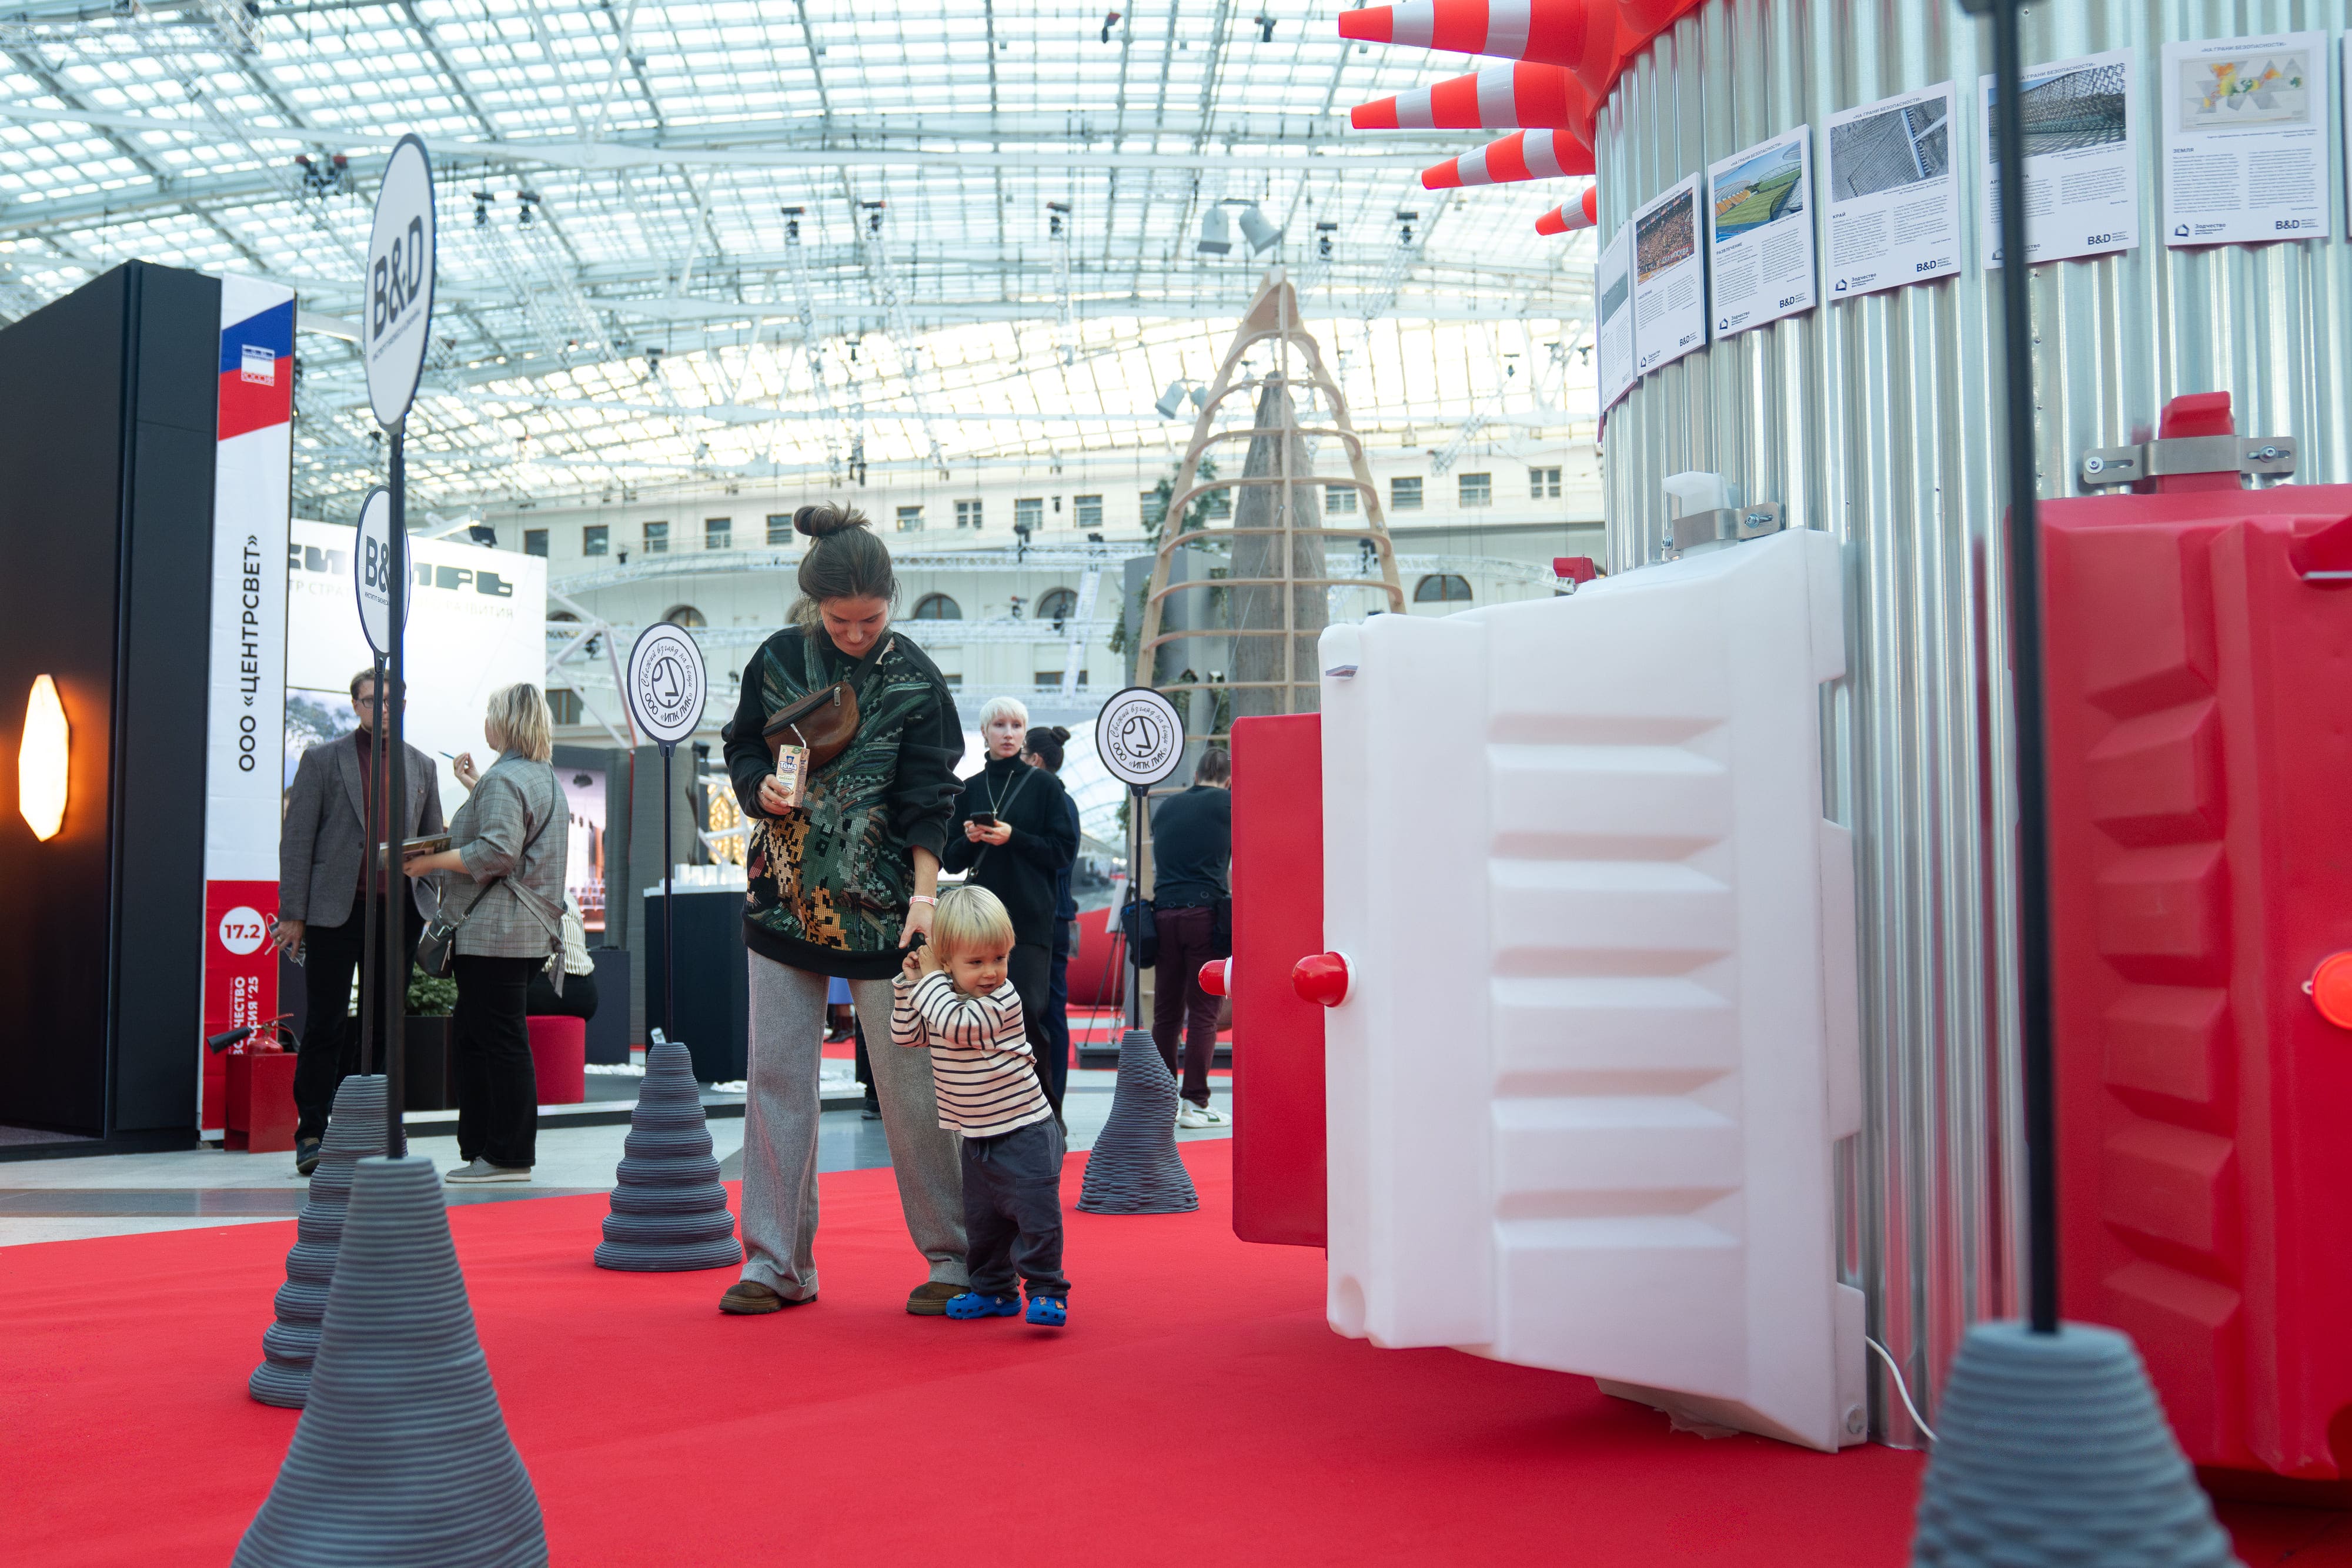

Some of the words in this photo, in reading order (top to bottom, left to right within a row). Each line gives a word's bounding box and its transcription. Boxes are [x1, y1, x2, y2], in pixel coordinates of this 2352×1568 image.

[1863, 109, 1879, 117] ГРАНИ
[2276, 220, 2300, 229] B&D
[2088, 234, 2110, 245] B&D
[373, 215, 423, 342] B&D
[1852, 273, 1876, 282] Зодчество
[1916, 260, 1936, 272] B&D
[1779, 296, 1795, 308] B&D
[1679, 335, 1690, 346] B&D
[365, 535, 390, 593] B&
[240, 534, 261, 707] «ЦЕНТРСВЕТ»
[640, 649, 657, 687] Свежий
[657, 643, 679, 657] взгляд
[679, 653, 687, 663] на
[644, 693, 659, 716] ООО
[660, 712, 680, 723] «ИПК
[679, 692, 693, 718] ЛИК»
[1110, 708, 1130, 738] Свежий
[1131, 704, 1155, 716] взгляд
[1155, 714, 1164, 724] на
[1161, 724, 1170, 745] вещи
[239, 715, 256, 772] ООО
[1112, 742, 1127, 761] ООО
[1128, 760, 1151, 770] «ИПК
[1151, 747, 1168, 767] ЛИК»
[225, 924, 260, 939] 17.2
[233, 976, 246, 1054] ЗОЧЕСТВО
